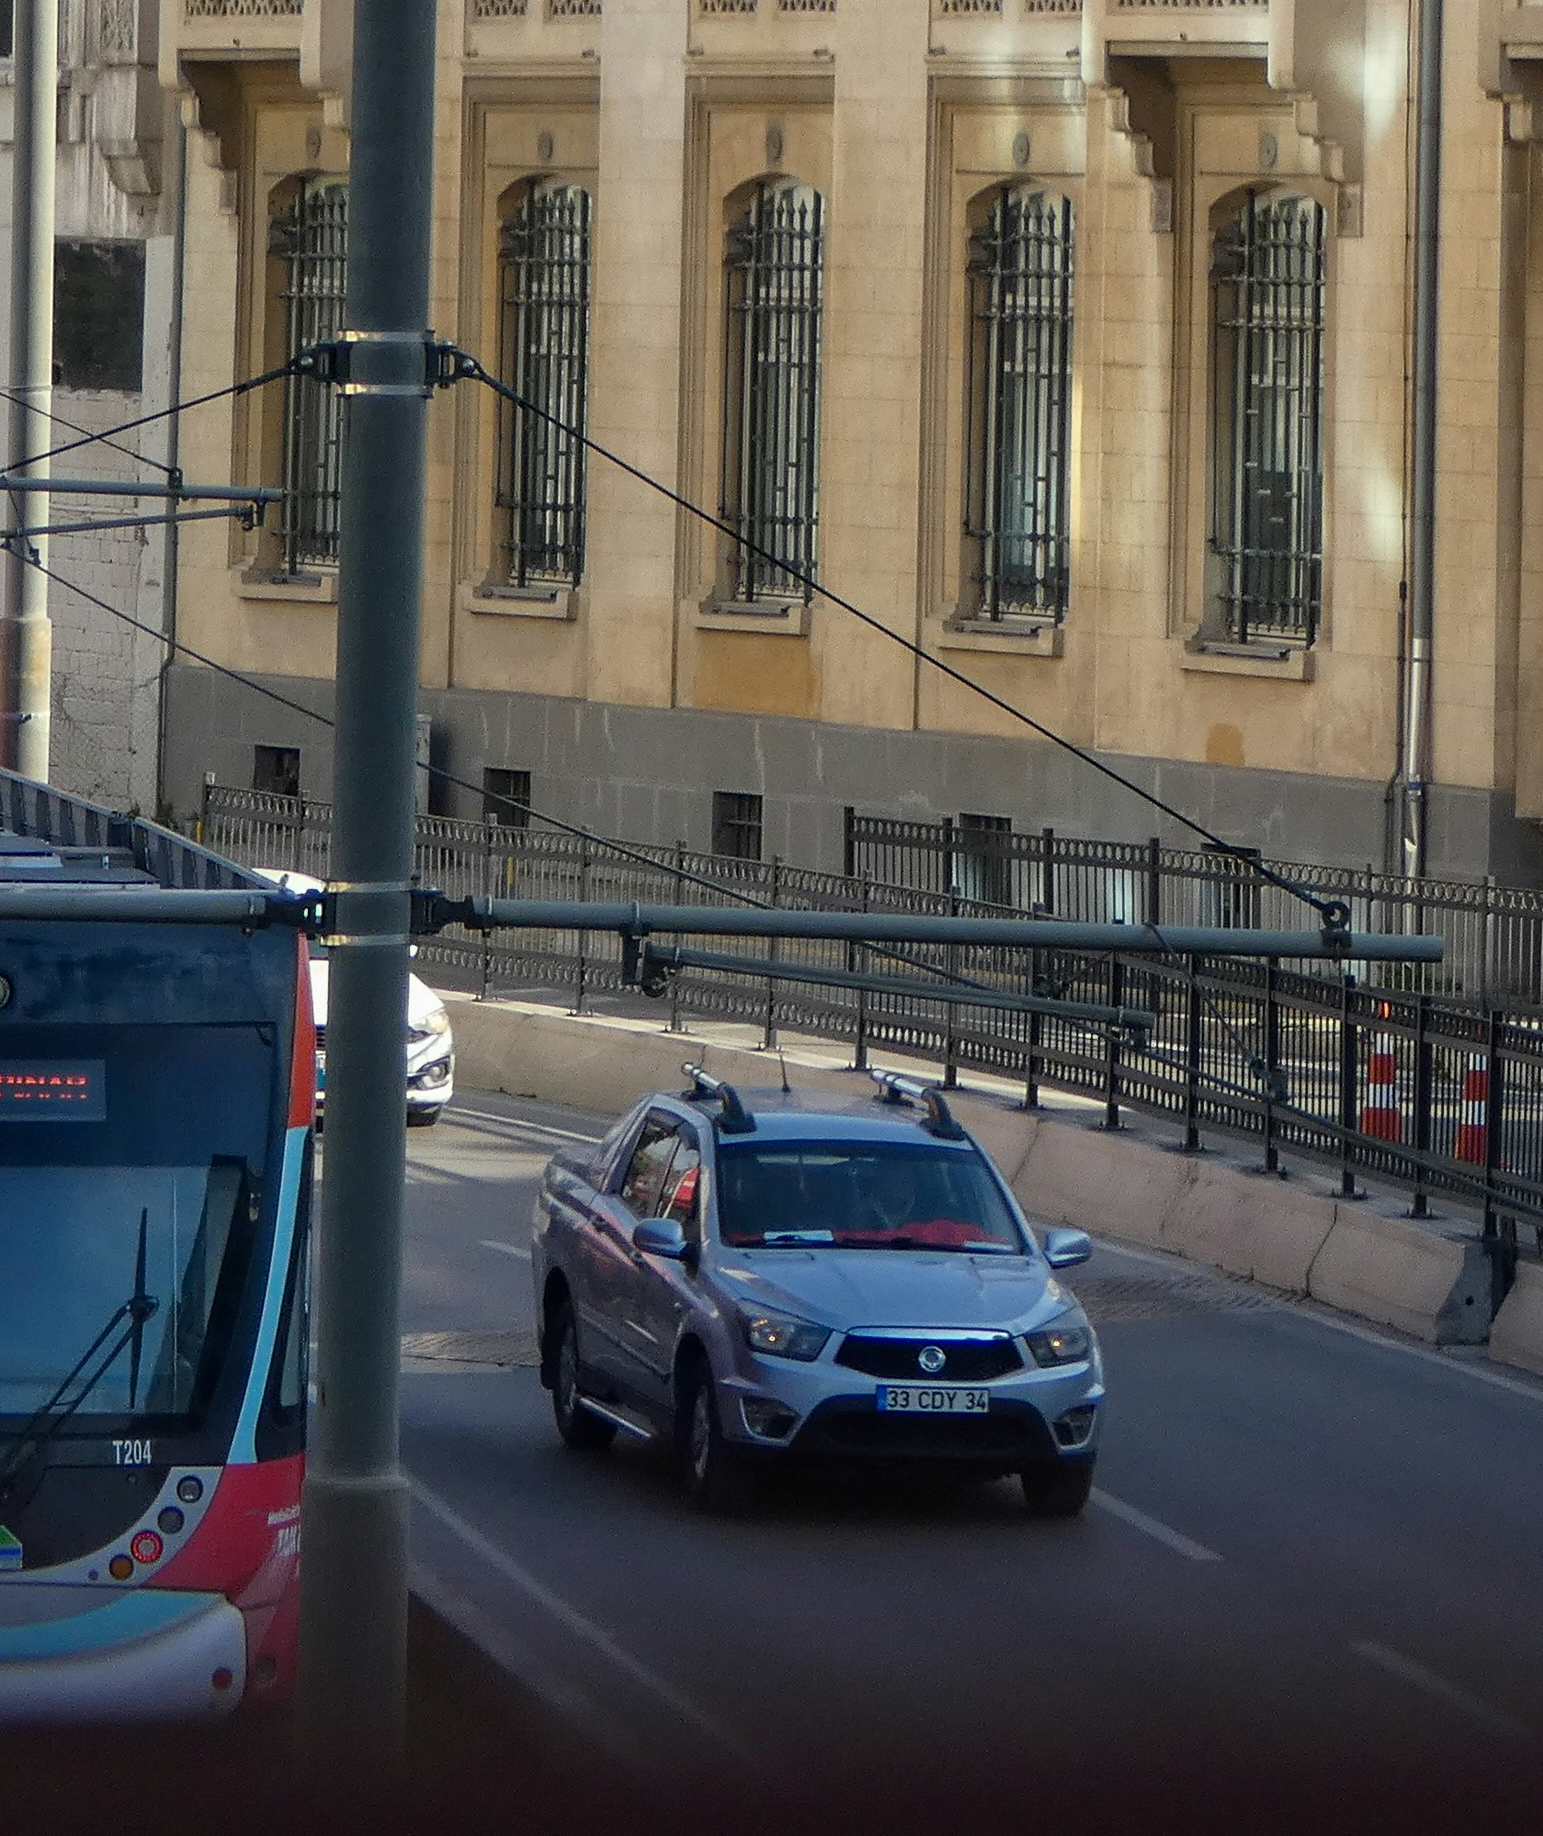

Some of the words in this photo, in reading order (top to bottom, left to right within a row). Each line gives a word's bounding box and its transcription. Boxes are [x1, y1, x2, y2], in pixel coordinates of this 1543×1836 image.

[887, 1390, 909, 1408] 33
[918, 1391, 956, 1409] CDY
[965, 1392, 986, 1411] 34
[112, 1439, 151, 1464] T204
